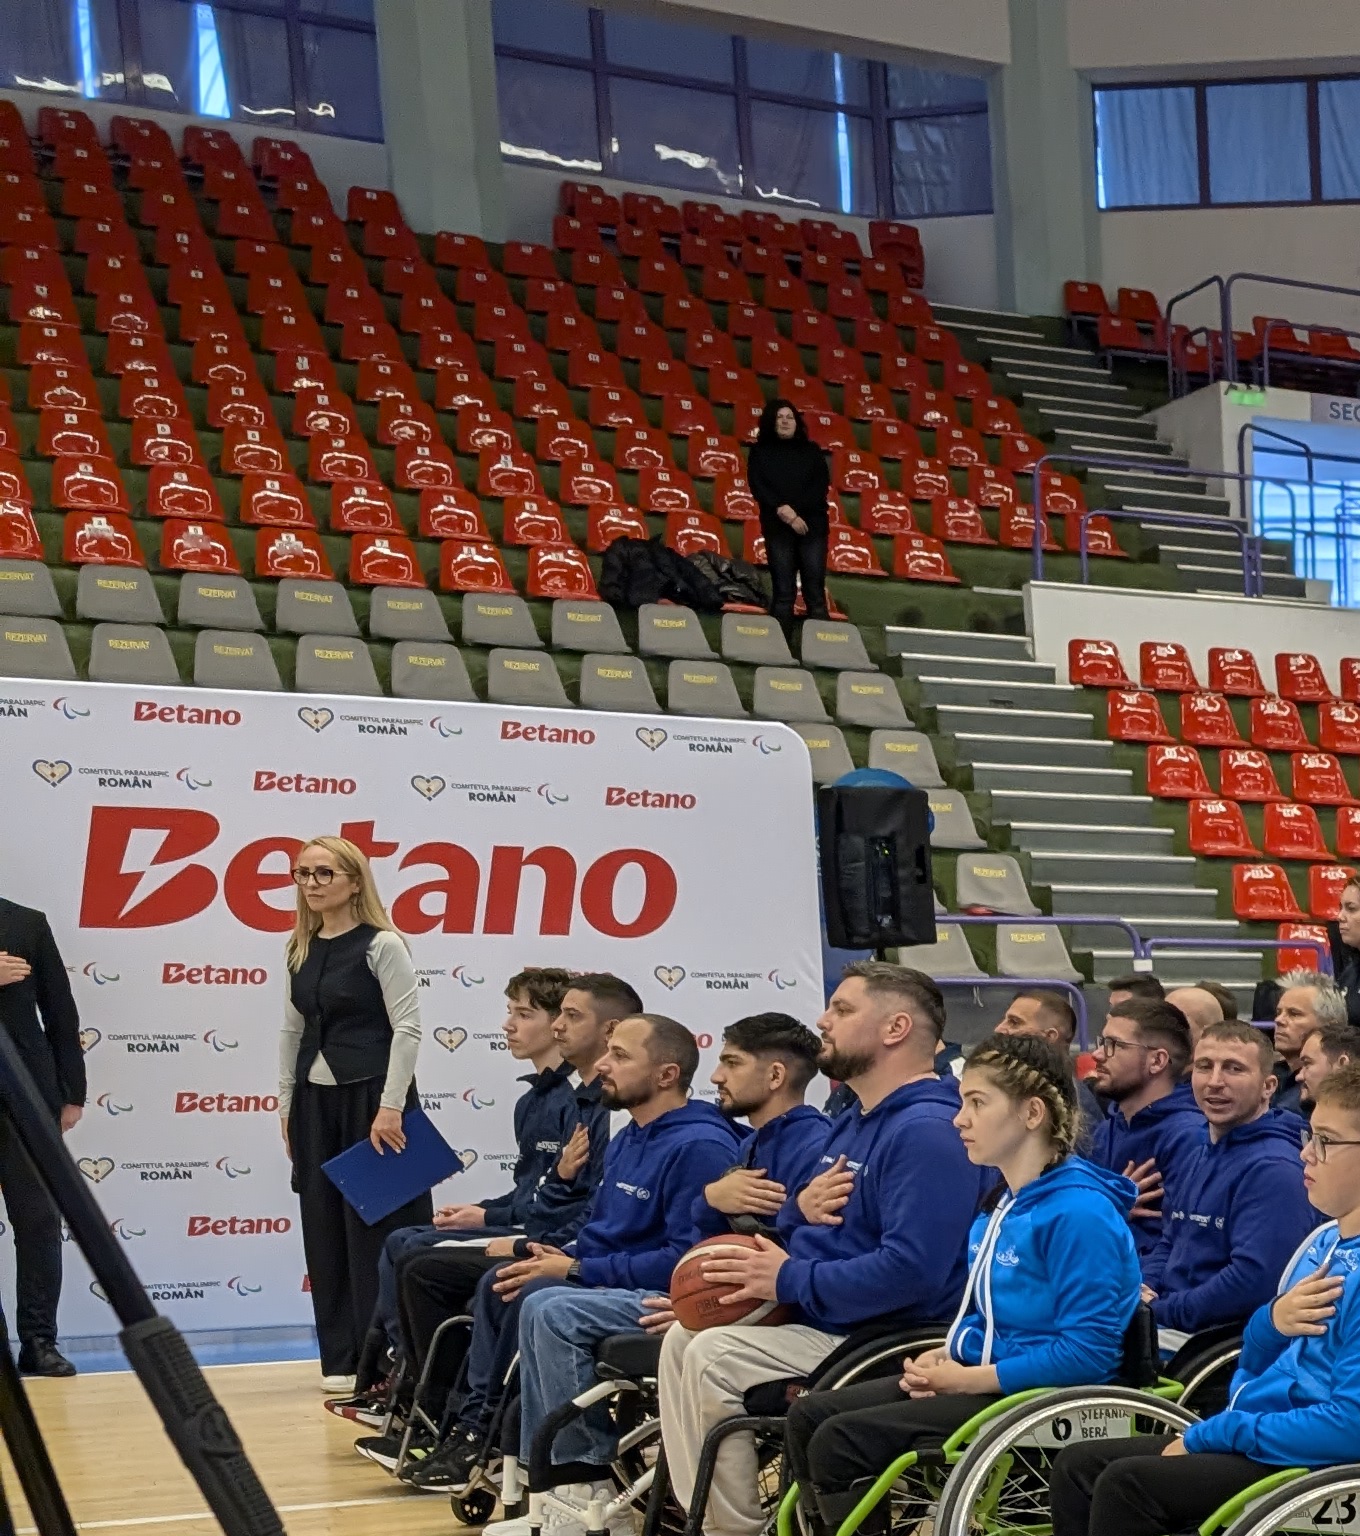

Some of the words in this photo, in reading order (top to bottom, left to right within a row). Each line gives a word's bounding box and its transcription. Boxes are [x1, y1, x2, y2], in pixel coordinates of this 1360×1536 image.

[97, 579, 138, 590] REZERVAT
[198, 587, 236, 599] REZERVAT
[294, 590, 333, 603] REZERVAT
[387, 600, 423, 610] REZERVAT
[477, 604, 513, 616] REZERVAT
[567, 612, 602, 622] REZERVAT
[653, 618, 687, 628] REZERVAT
[5, 631, 48, 643] REZERVAT
[736, 625, 770, 636] REZERVAT
[816, 632, 849, 642] REZERVAT
[108, 638, 150, 651] REZERVAT
[213, 645, 254, 656] REZERVAT
[314, 649, 353, 661] REZERVAT
[408, 655, 445, 667] REZERVAT
[503, 660, 540, 671] REZERVAT
[597, 668, 633, 679] REZERVAT
[683, 673, 717, 684] REZERVAT
[770, 680, 803, 691] REZERVAT
[851, 684, 884, 695] REZERVAT
[134, 701, 242, 726] Betano
[358, 723, 408, 736] ROMÂN
[500, 720, 596, 745] Betano
[688, 741, 733, 754] ROMÂN
[98, 775, 153, 789] ROMÂN
[253, 770, 357, 795] Betano
[468, 790, 516, 804] ROMÂN
[605, 786, 697, 810] Betano
[79, 805, 678, 939] Betano
[973, 867, 1007, 878] REZERVAT
[162, 962, 268, 986] Betano
[705, 978, 749, 991] ROMÂN
[127, 1037, 180, 1054] ROMÂN
[175, 1092, 279, 1114] Betano
[140, 1167, 193, 1182] ROMÂN
[187, 1215, 291, 1238] Betano
[152, 1287, 205, 1302] ROMÂN
[1082, 1425, 1108, 1439] BERA
[1311, 1492, 1357, 1526] 23
